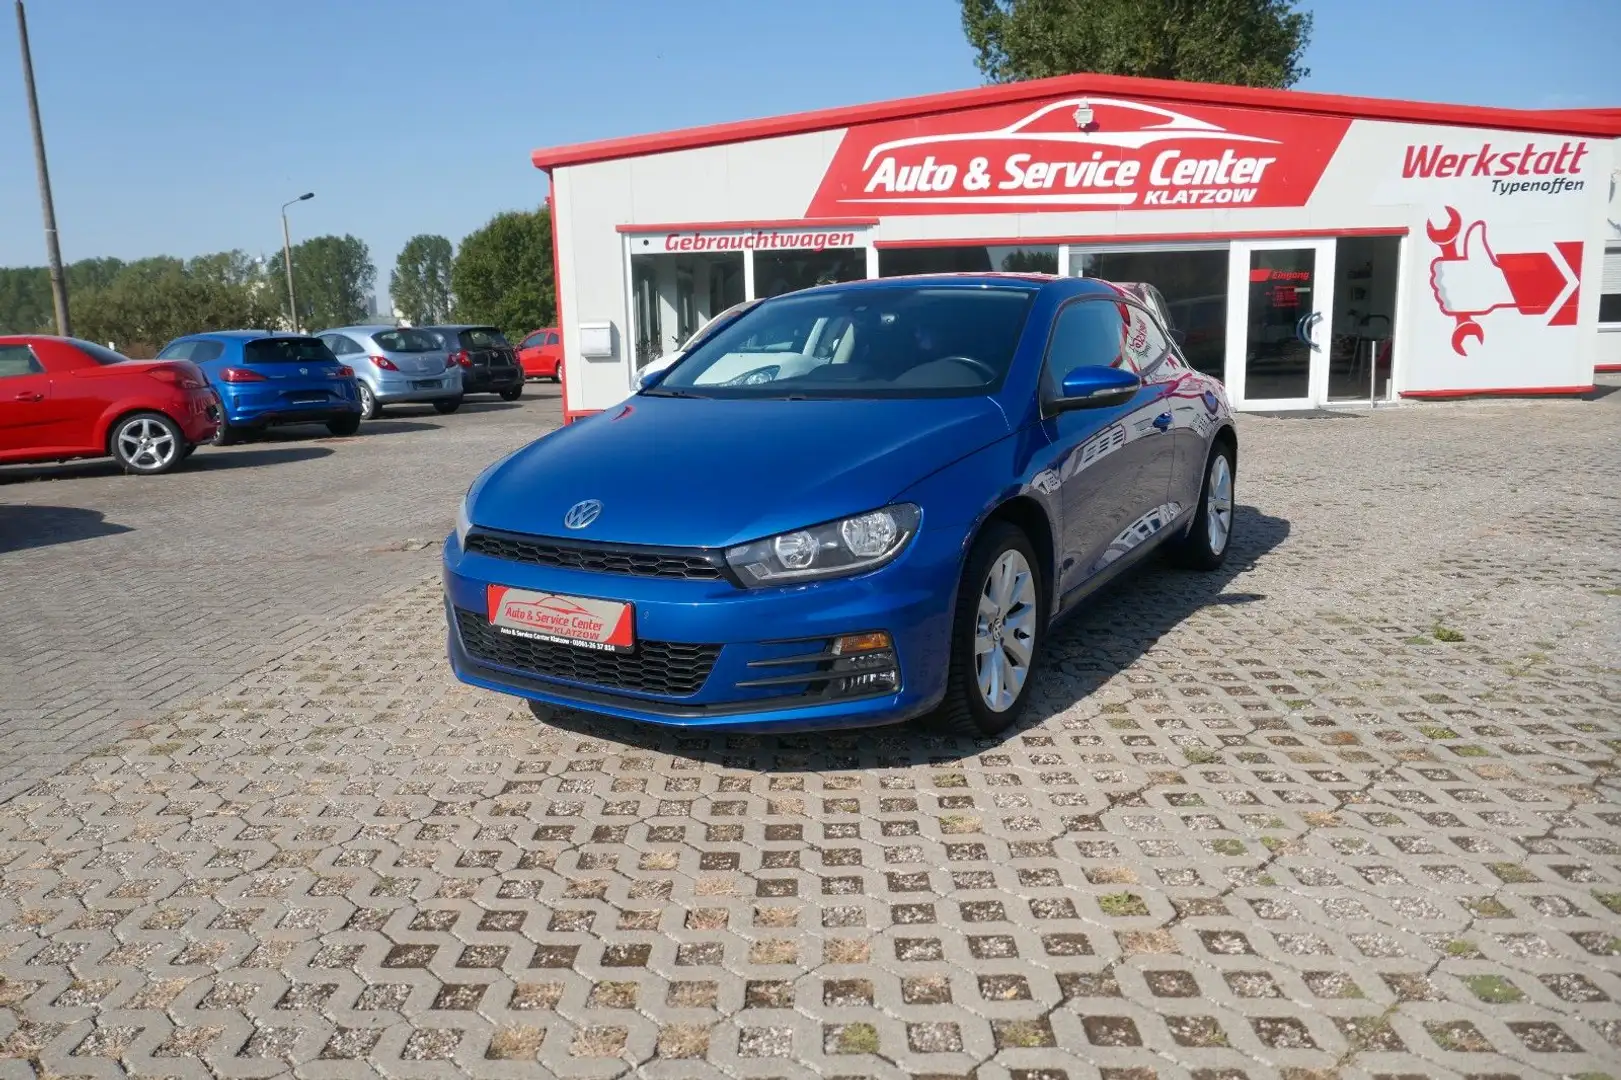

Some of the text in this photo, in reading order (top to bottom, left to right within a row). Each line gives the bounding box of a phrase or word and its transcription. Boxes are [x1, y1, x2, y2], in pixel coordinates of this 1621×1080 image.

[1402, 142, 1588, 178] Werkstatt
[864, 149, 1276, 193] Auto & Service Center
[1143, 188, 1257, 205] KLATZOW
[1491, 177, 1585, 196] Typenoffen
[665, 230, 855, 252] Gebrauchtwagen
[1272, 270, 1310, 281] Eingang
[505, 606, 604, 631] Auto & Service Center
[554, 626, 600, 640] KLATZOW
